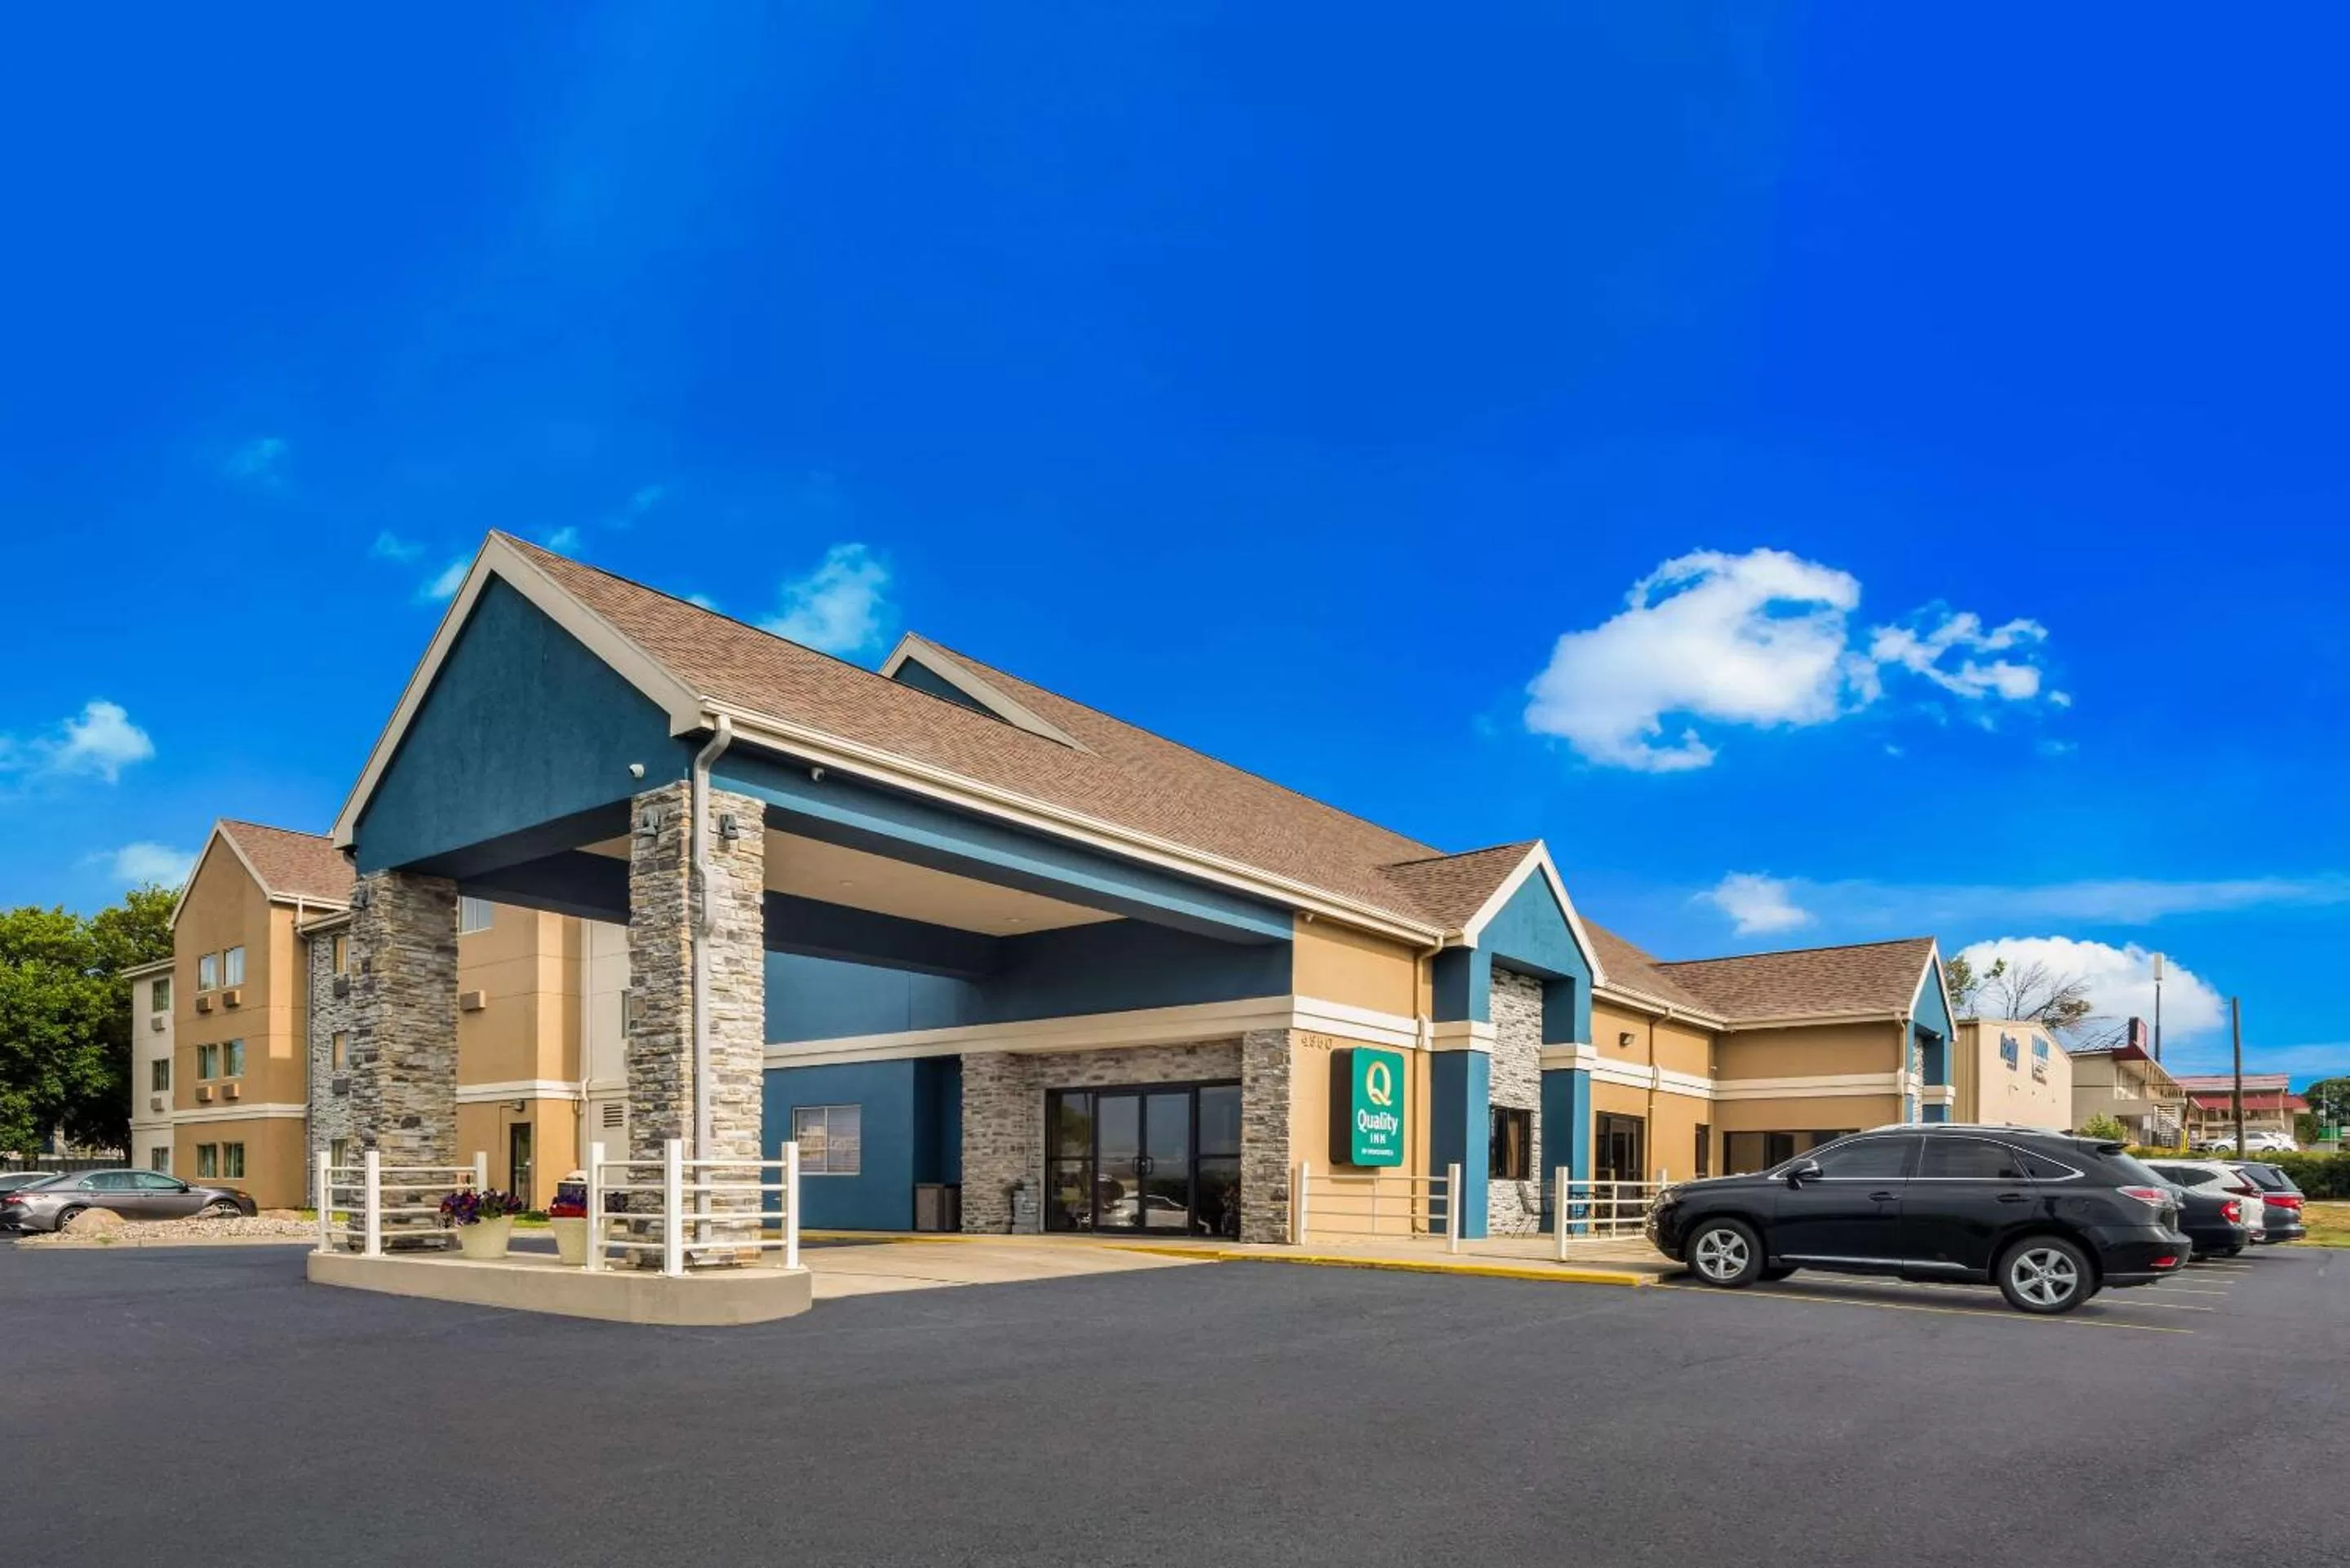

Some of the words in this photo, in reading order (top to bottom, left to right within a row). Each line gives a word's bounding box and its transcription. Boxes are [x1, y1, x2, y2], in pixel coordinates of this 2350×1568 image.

[1366, 1061, 1392, 1106] Q
[1357, 1108, 1399, 1136] Quality
[1370, 1132, 1386, 1144] INN
